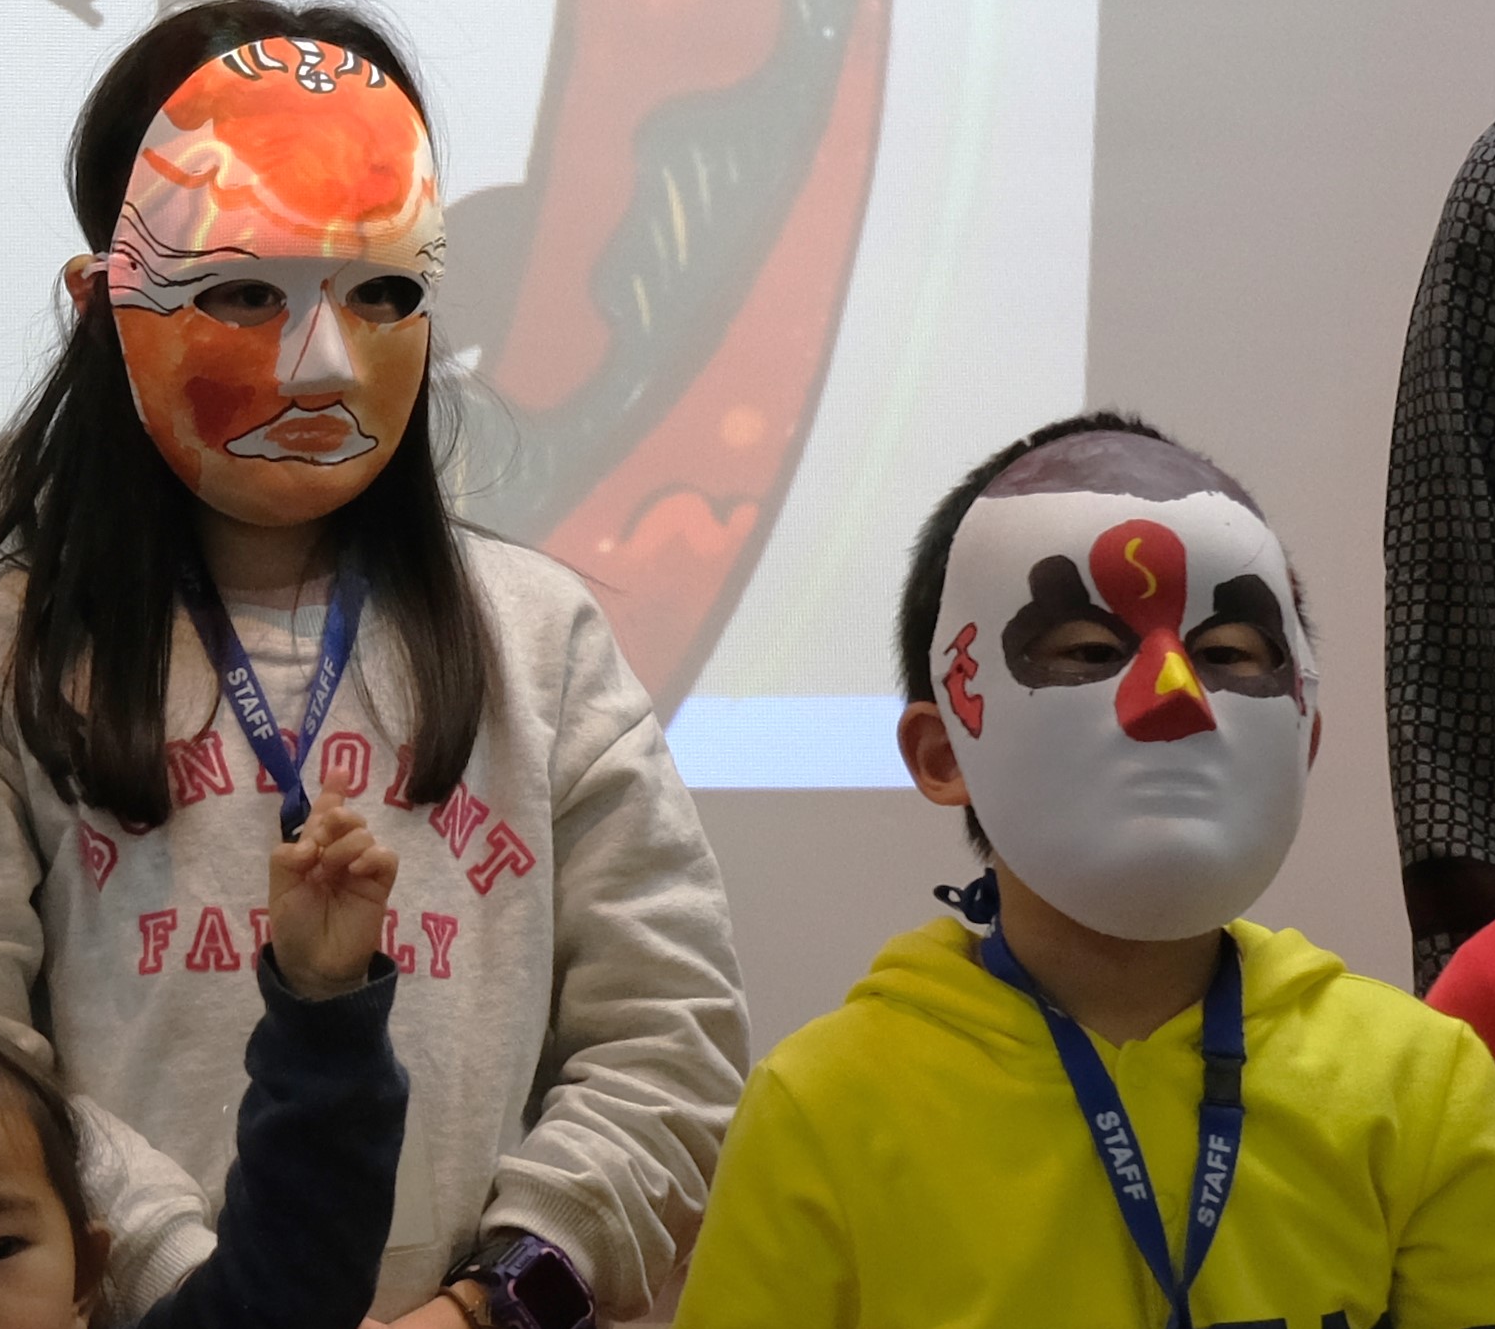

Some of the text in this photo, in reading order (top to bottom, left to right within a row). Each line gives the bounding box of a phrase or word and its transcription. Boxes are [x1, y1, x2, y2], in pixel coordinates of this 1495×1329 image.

[227, 667, 274, 742] STAFF
[306, 656, 338, 735] STAFF
[139, 907, 458, 978] FALY
[1095, 1110, 1148, 1201] STAFF
[1196, 1134, 1232, 1228] STAFF
